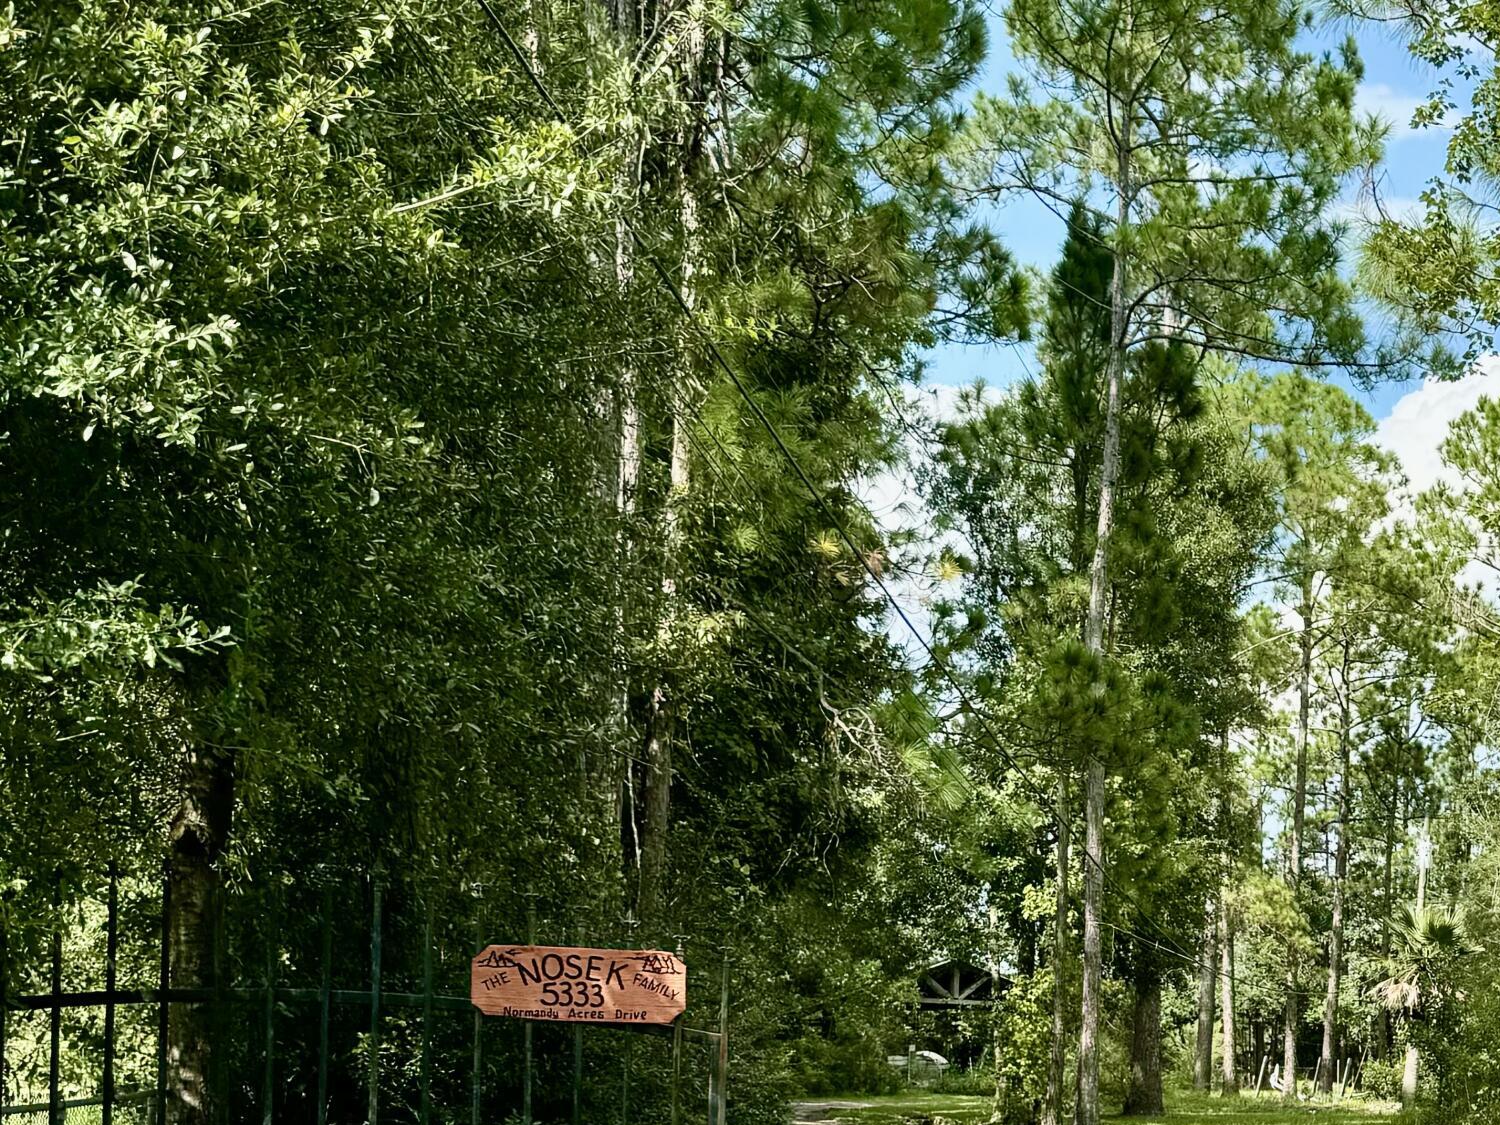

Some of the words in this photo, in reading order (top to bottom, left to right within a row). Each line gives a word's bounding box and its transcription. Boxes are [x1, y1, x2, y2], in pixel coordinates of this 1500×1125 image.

[481, 972, 511, 991] THE
[517, 954, 629, 990] NOSEK
[632, 973, 680, 1001] FAMILY
[539, 981, 605, 1008] 5333
[502, 1005, 560, 1020] Normandy
[567, 1008, 605, 1020] Acres
[615, 1009, 648, 1020] Drive
